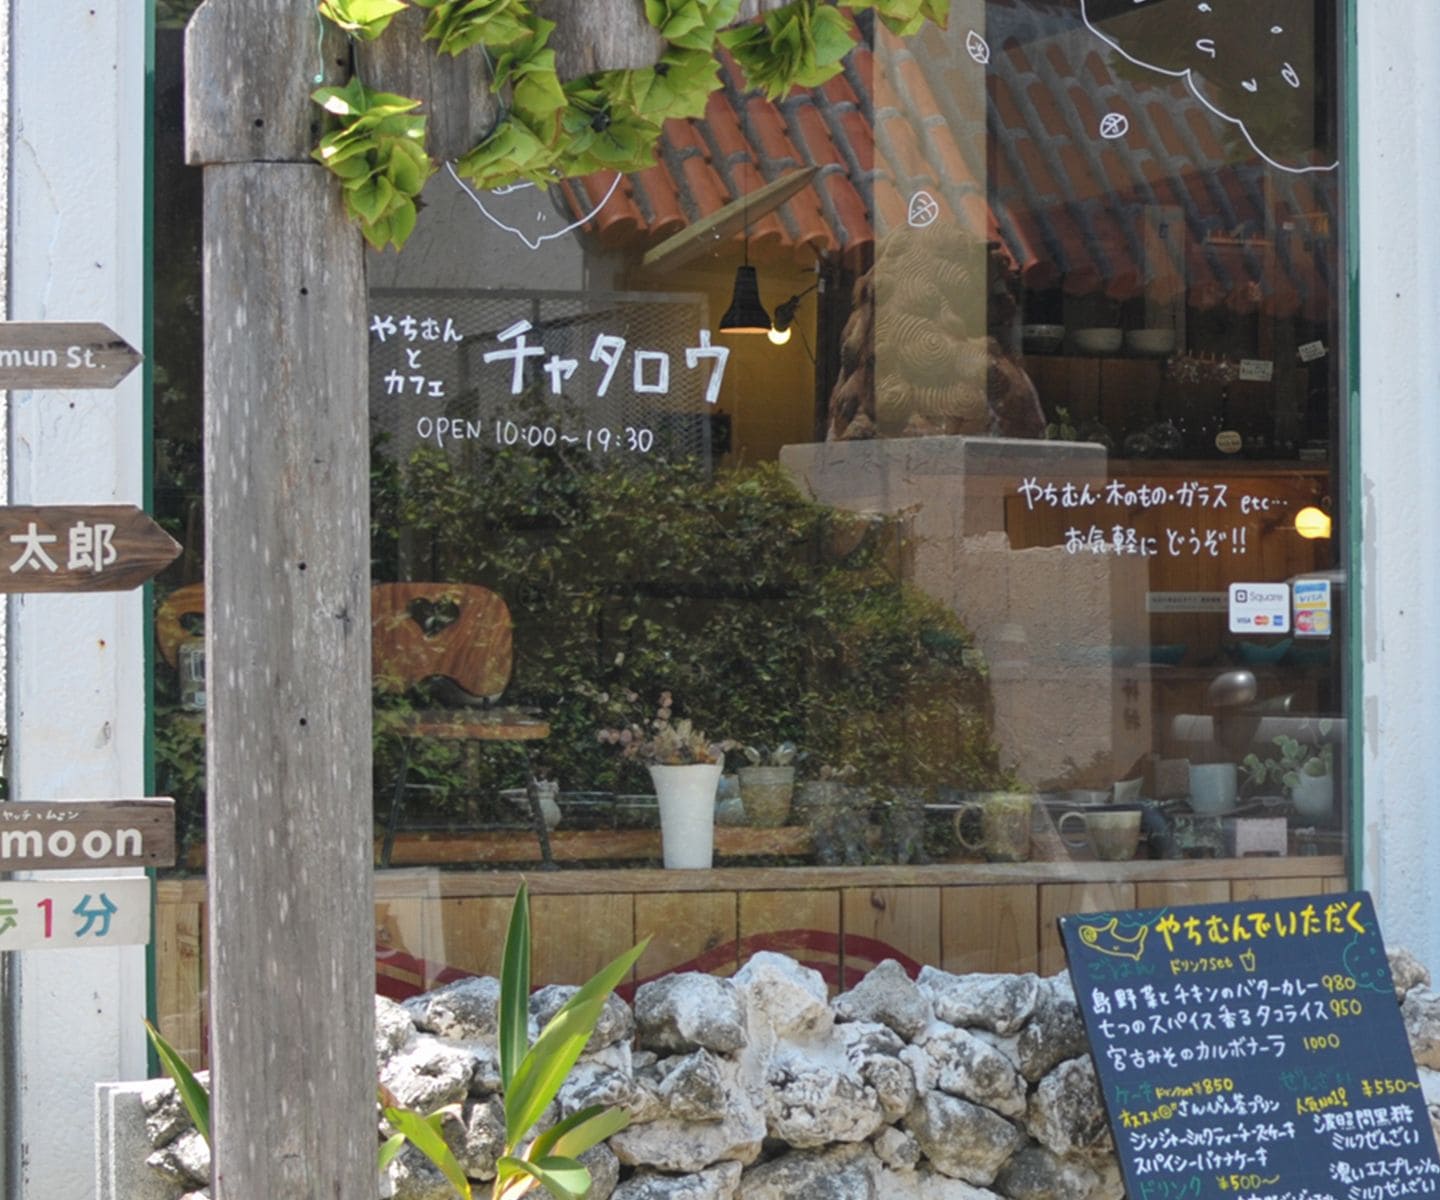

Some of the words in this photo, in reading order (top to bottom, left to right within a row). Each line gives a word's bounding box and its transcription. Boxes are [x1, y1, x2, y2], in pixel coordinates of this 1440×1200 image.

[370, 315, 463, 342] やちむん
[0, 349, 57, 367] mun
[66, 346, 107, 369] St.
[406, 348, 421, 368] と
[484, 320, 730, 403] チャタロウ
[384, 370, 445, 397] カフェ
[417, 416, 481, 447] OPEN
[9, 520, 118, 573] 太郎
[2, 827, 143, 859] moon
[1155, 901, 1366, 951] やちむんでいただく
[1322, 974, 1356, 993] 980
[1330, 999, 1363, 1018] 950
[1303, 1033, 1340, 1053] 1000
[1332, 1126, 1419, 1150] ミルクぜんざい
[1134, 1147, 1268, 1175] スパイシーバナナケーキ
